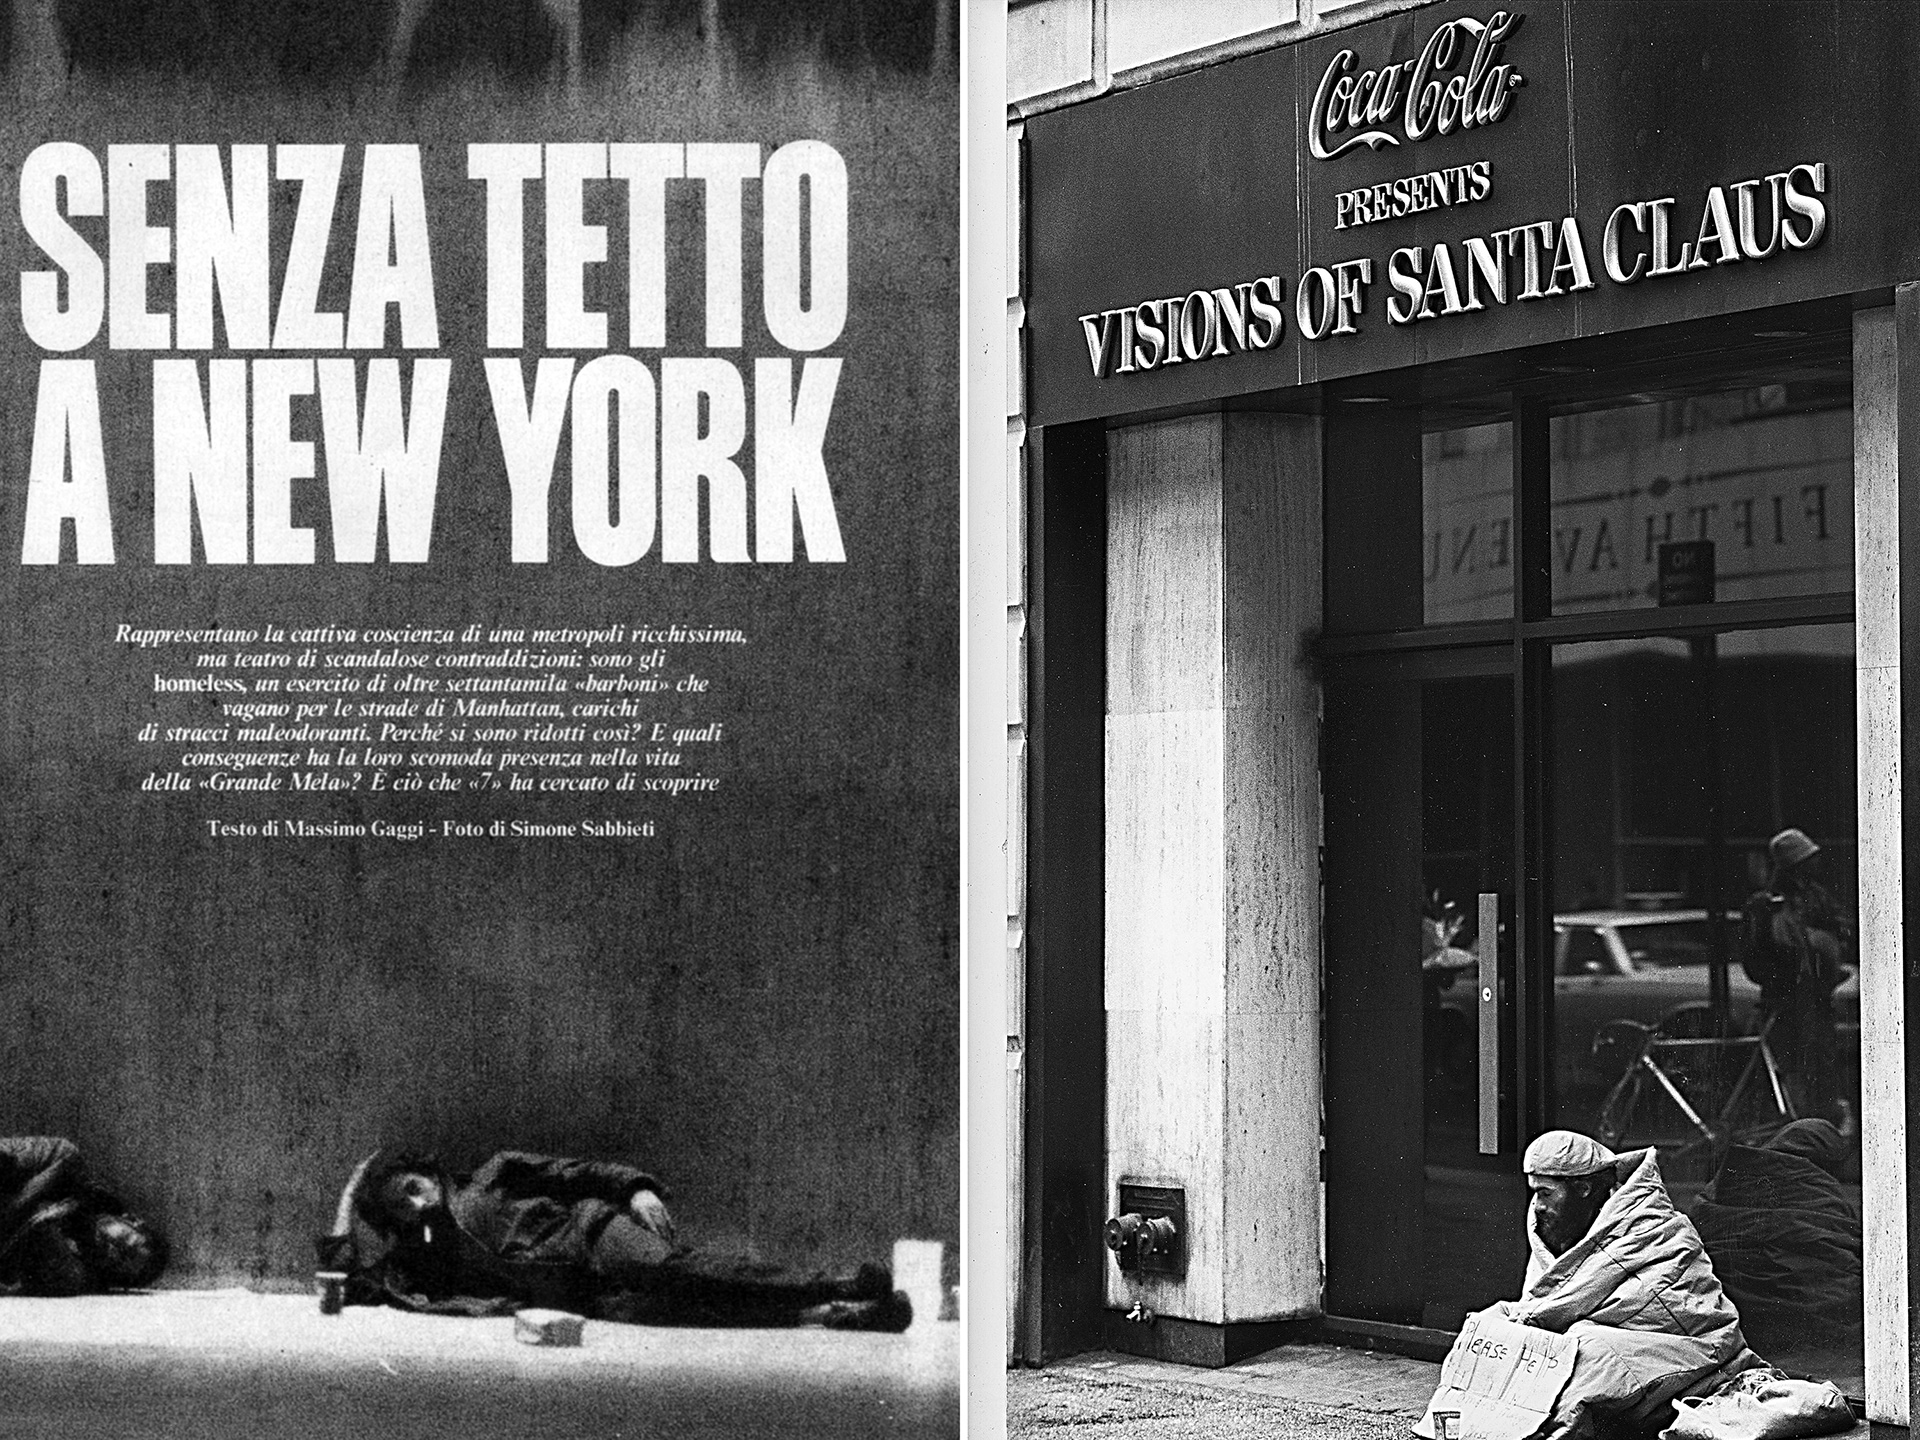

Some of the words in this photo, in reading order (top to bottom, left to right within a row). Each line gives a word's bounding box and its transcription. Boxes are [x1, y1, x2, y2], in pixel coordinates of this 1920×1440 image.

[1308, 11, 1515, 160] Coca-Cola
[1078, 276, 1282, 377] VISIONS
[1296, 258, 1371, 339] OF
[1387, 217, 1595, 325] SANTA
[1603, 162, 1826, 284] CLAUS
[1334, 161, 1491, 230] PRESENTS
